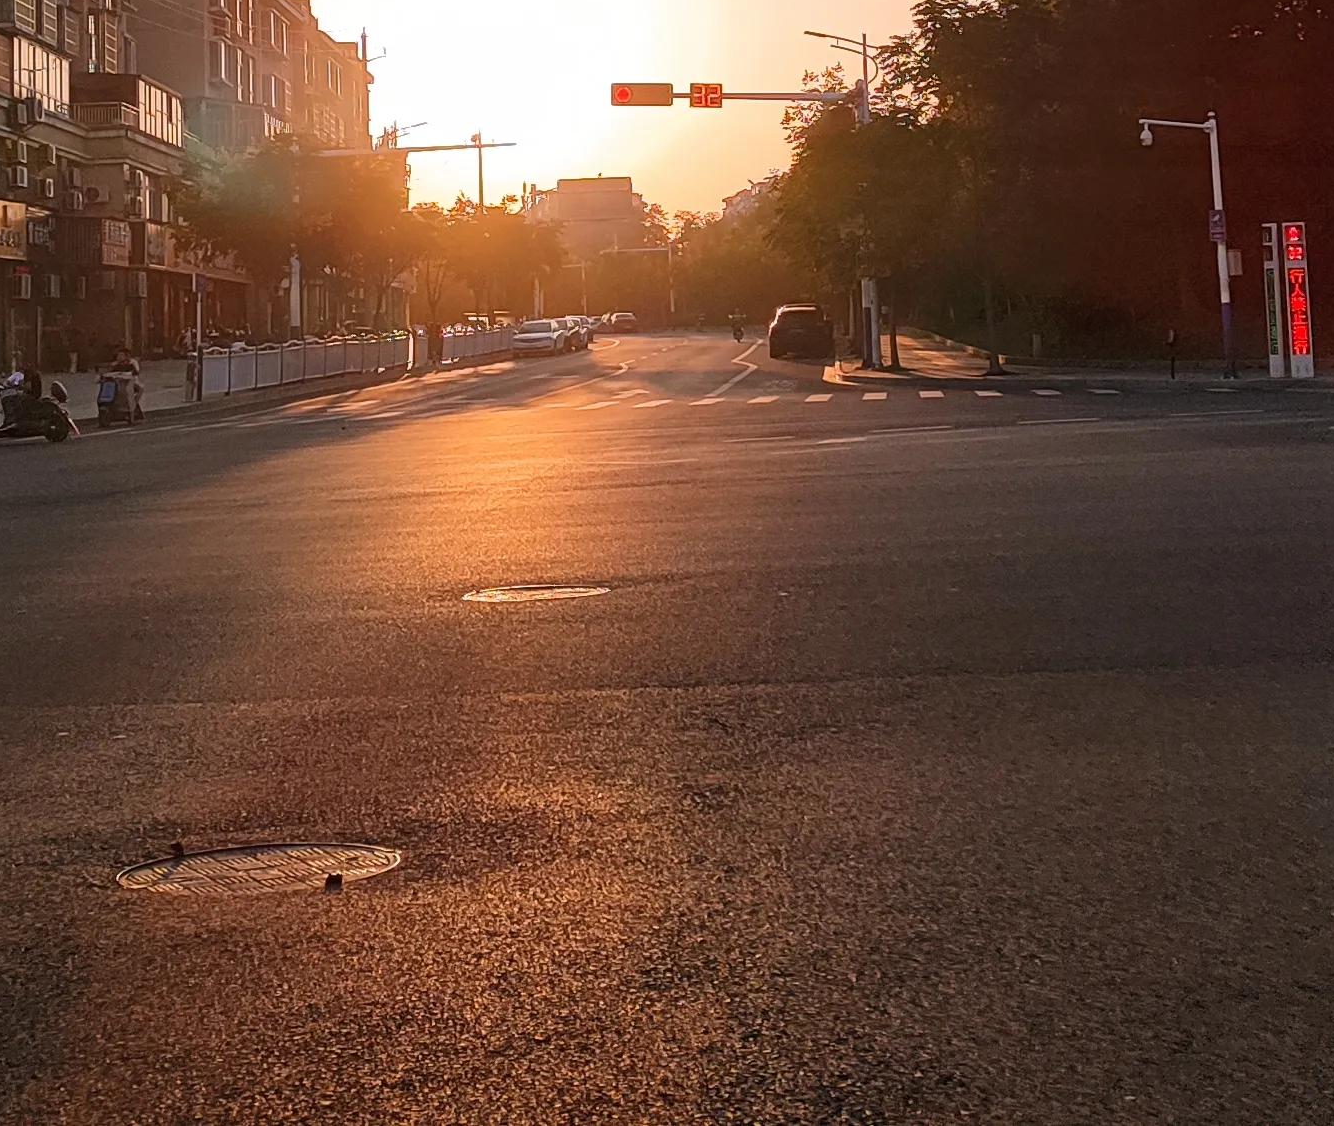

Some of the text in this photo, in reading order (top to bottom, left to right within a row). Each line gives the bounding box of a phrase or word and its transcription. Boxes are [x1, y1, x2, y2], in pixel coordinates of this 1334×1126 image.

[693, 84, 720, 106] 32
[1290, 270, 1310, 355] 行人禁止通行
